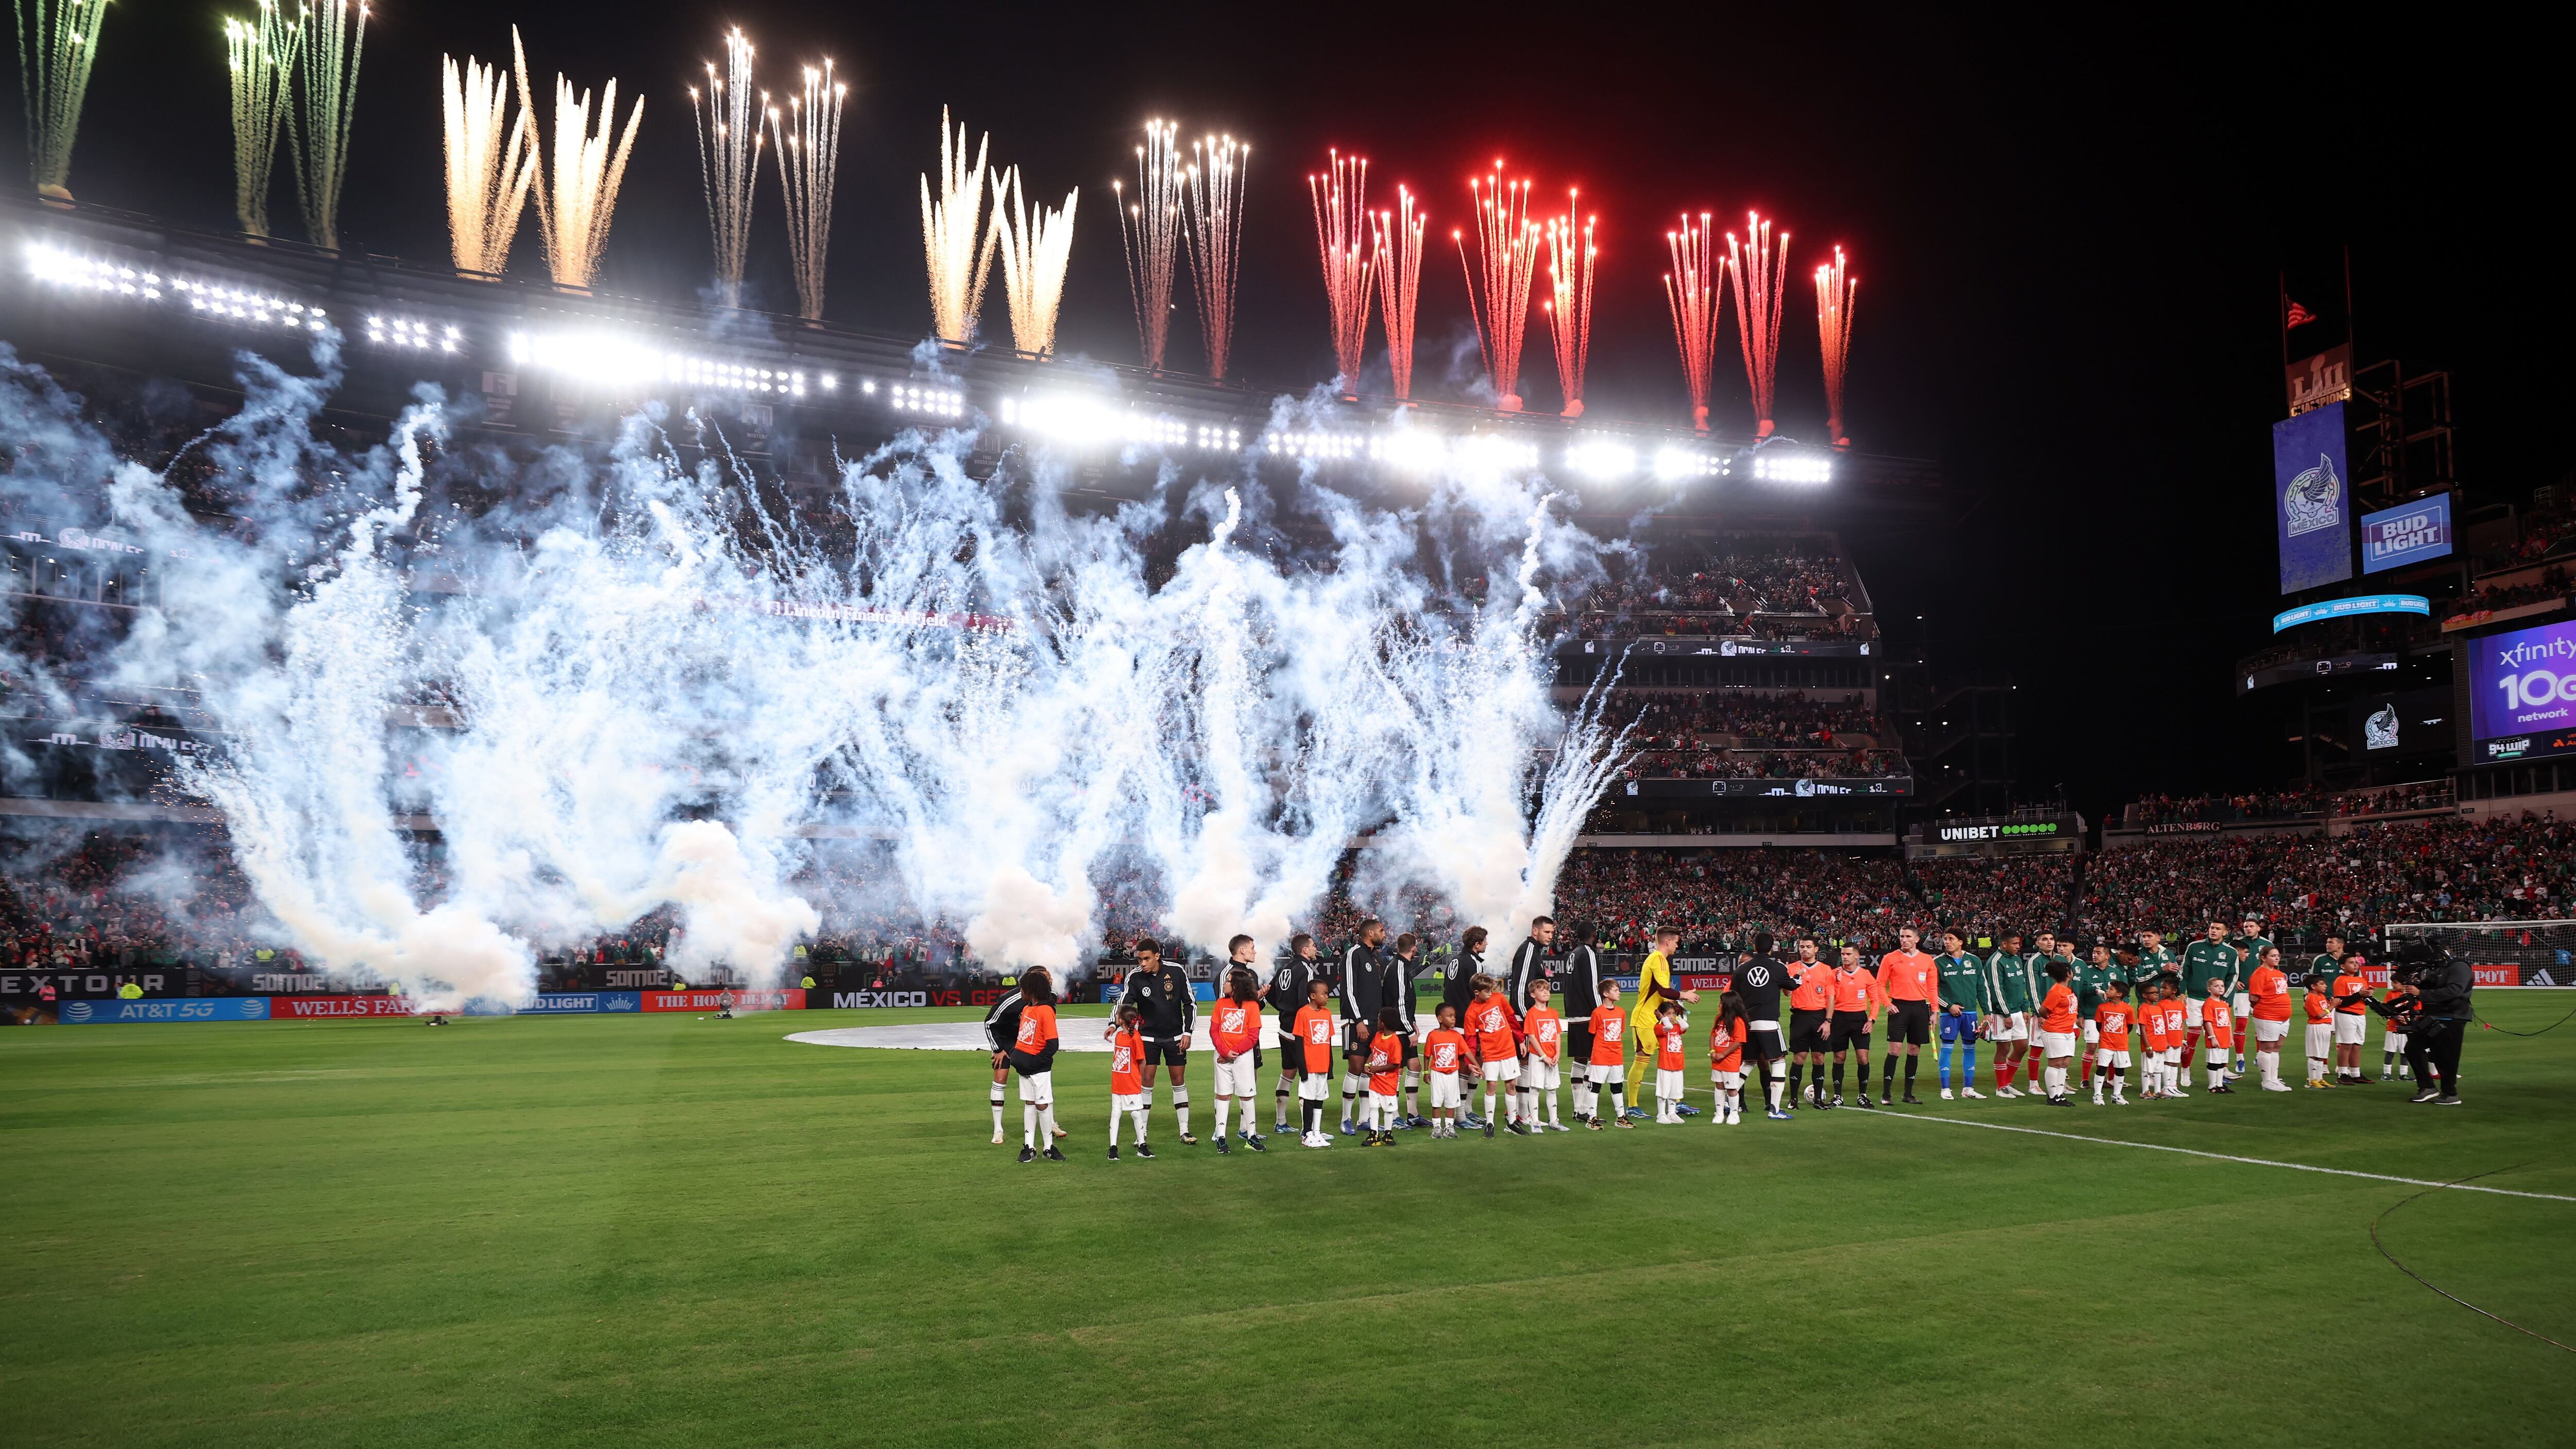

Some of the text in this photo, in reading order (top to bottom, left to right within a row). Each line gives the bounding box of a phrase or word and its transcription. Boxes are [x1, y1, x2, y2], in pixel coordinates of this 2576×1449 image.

[2292, 513, 2334, 533] MÉXICO
[2383, 515, 2428, 539] BUD
[2375, 526, 2437, 556] LIGHT
[2351, 601, 2377, 609] LIGHT
[784, 602, 948, 627] Lincoln Financial Field
[2281, 610, 2309, 624] BUD LIGHT
[1058, 621, 1090, 636] 0:00
[2500, 637, 2576, 668] xfinity
[2518, 708, 2569, 722] network
[2489, 744, 2505, 755] 94
[2506, 739, 2530, 752] WIP
[1941, 826, 1999, 841] UNIBET
[548, 997, 595, 1009] LIGHT
[656, 995, 687, 1008] THE
[834, 987, 926, 1009] MÉXICO
[119, 1003, 214, 1019] AT&T 5G
[292, 1000, 368, 1015] WELLS
[1222, 1009, 1243, 1031] HOME
[2105, 1013, 2124, 1032] HOME
[1436, 1044, 1454, 1066] HOME
